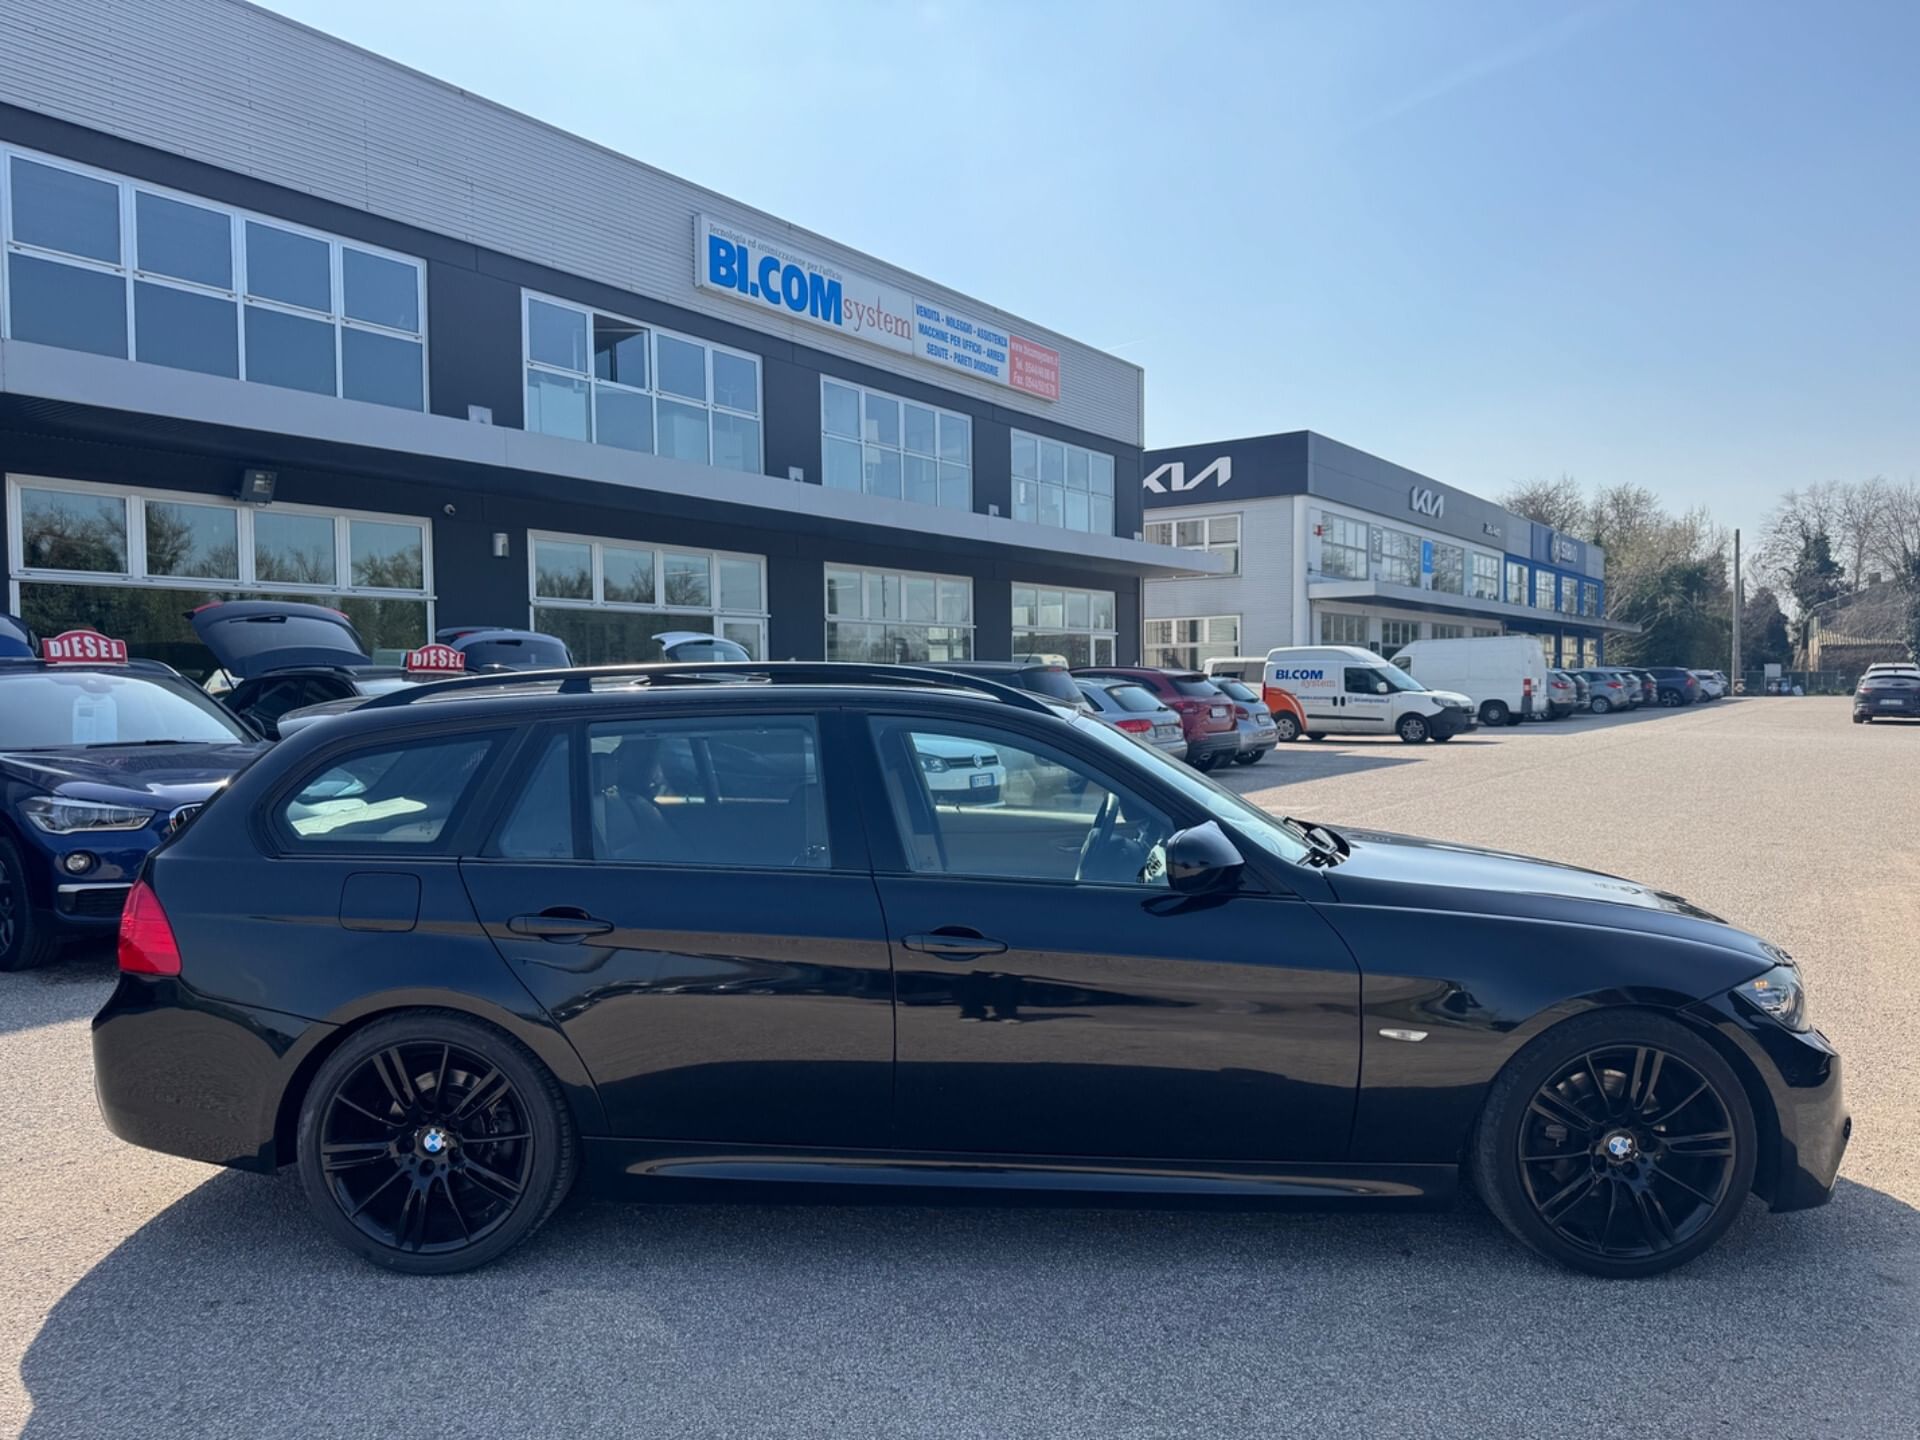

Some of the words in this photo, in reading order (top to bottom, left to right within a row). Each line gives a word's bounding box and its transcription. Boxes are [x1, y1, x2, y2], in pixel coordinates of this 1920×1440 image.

[708, 234, 842, 326] BI.COM
[843, 296, 912, 341] system
[916, 303, 941, 323] VENDITA
[945, 314, 973, 334] NOLEGGIO
[977, 327, 1008, 348] ASSISTENZA
[918, 322, 949, 343] MACCHINE
[950, 332, 961, 347] PER
[962, 337, 982, 355] UFFICIO
[926, 342, 949, 361] SEDUTE
[953, 352, 973, 369] PARETI
[1410, 485, 1444, 518] KIA
[48, 635, 123, 658] DIESEL
[412, 648, 463, 668] DIESEL
[1275, 669, 1324, 680] BI.COM
[1300, 679, 1336, 688] system
